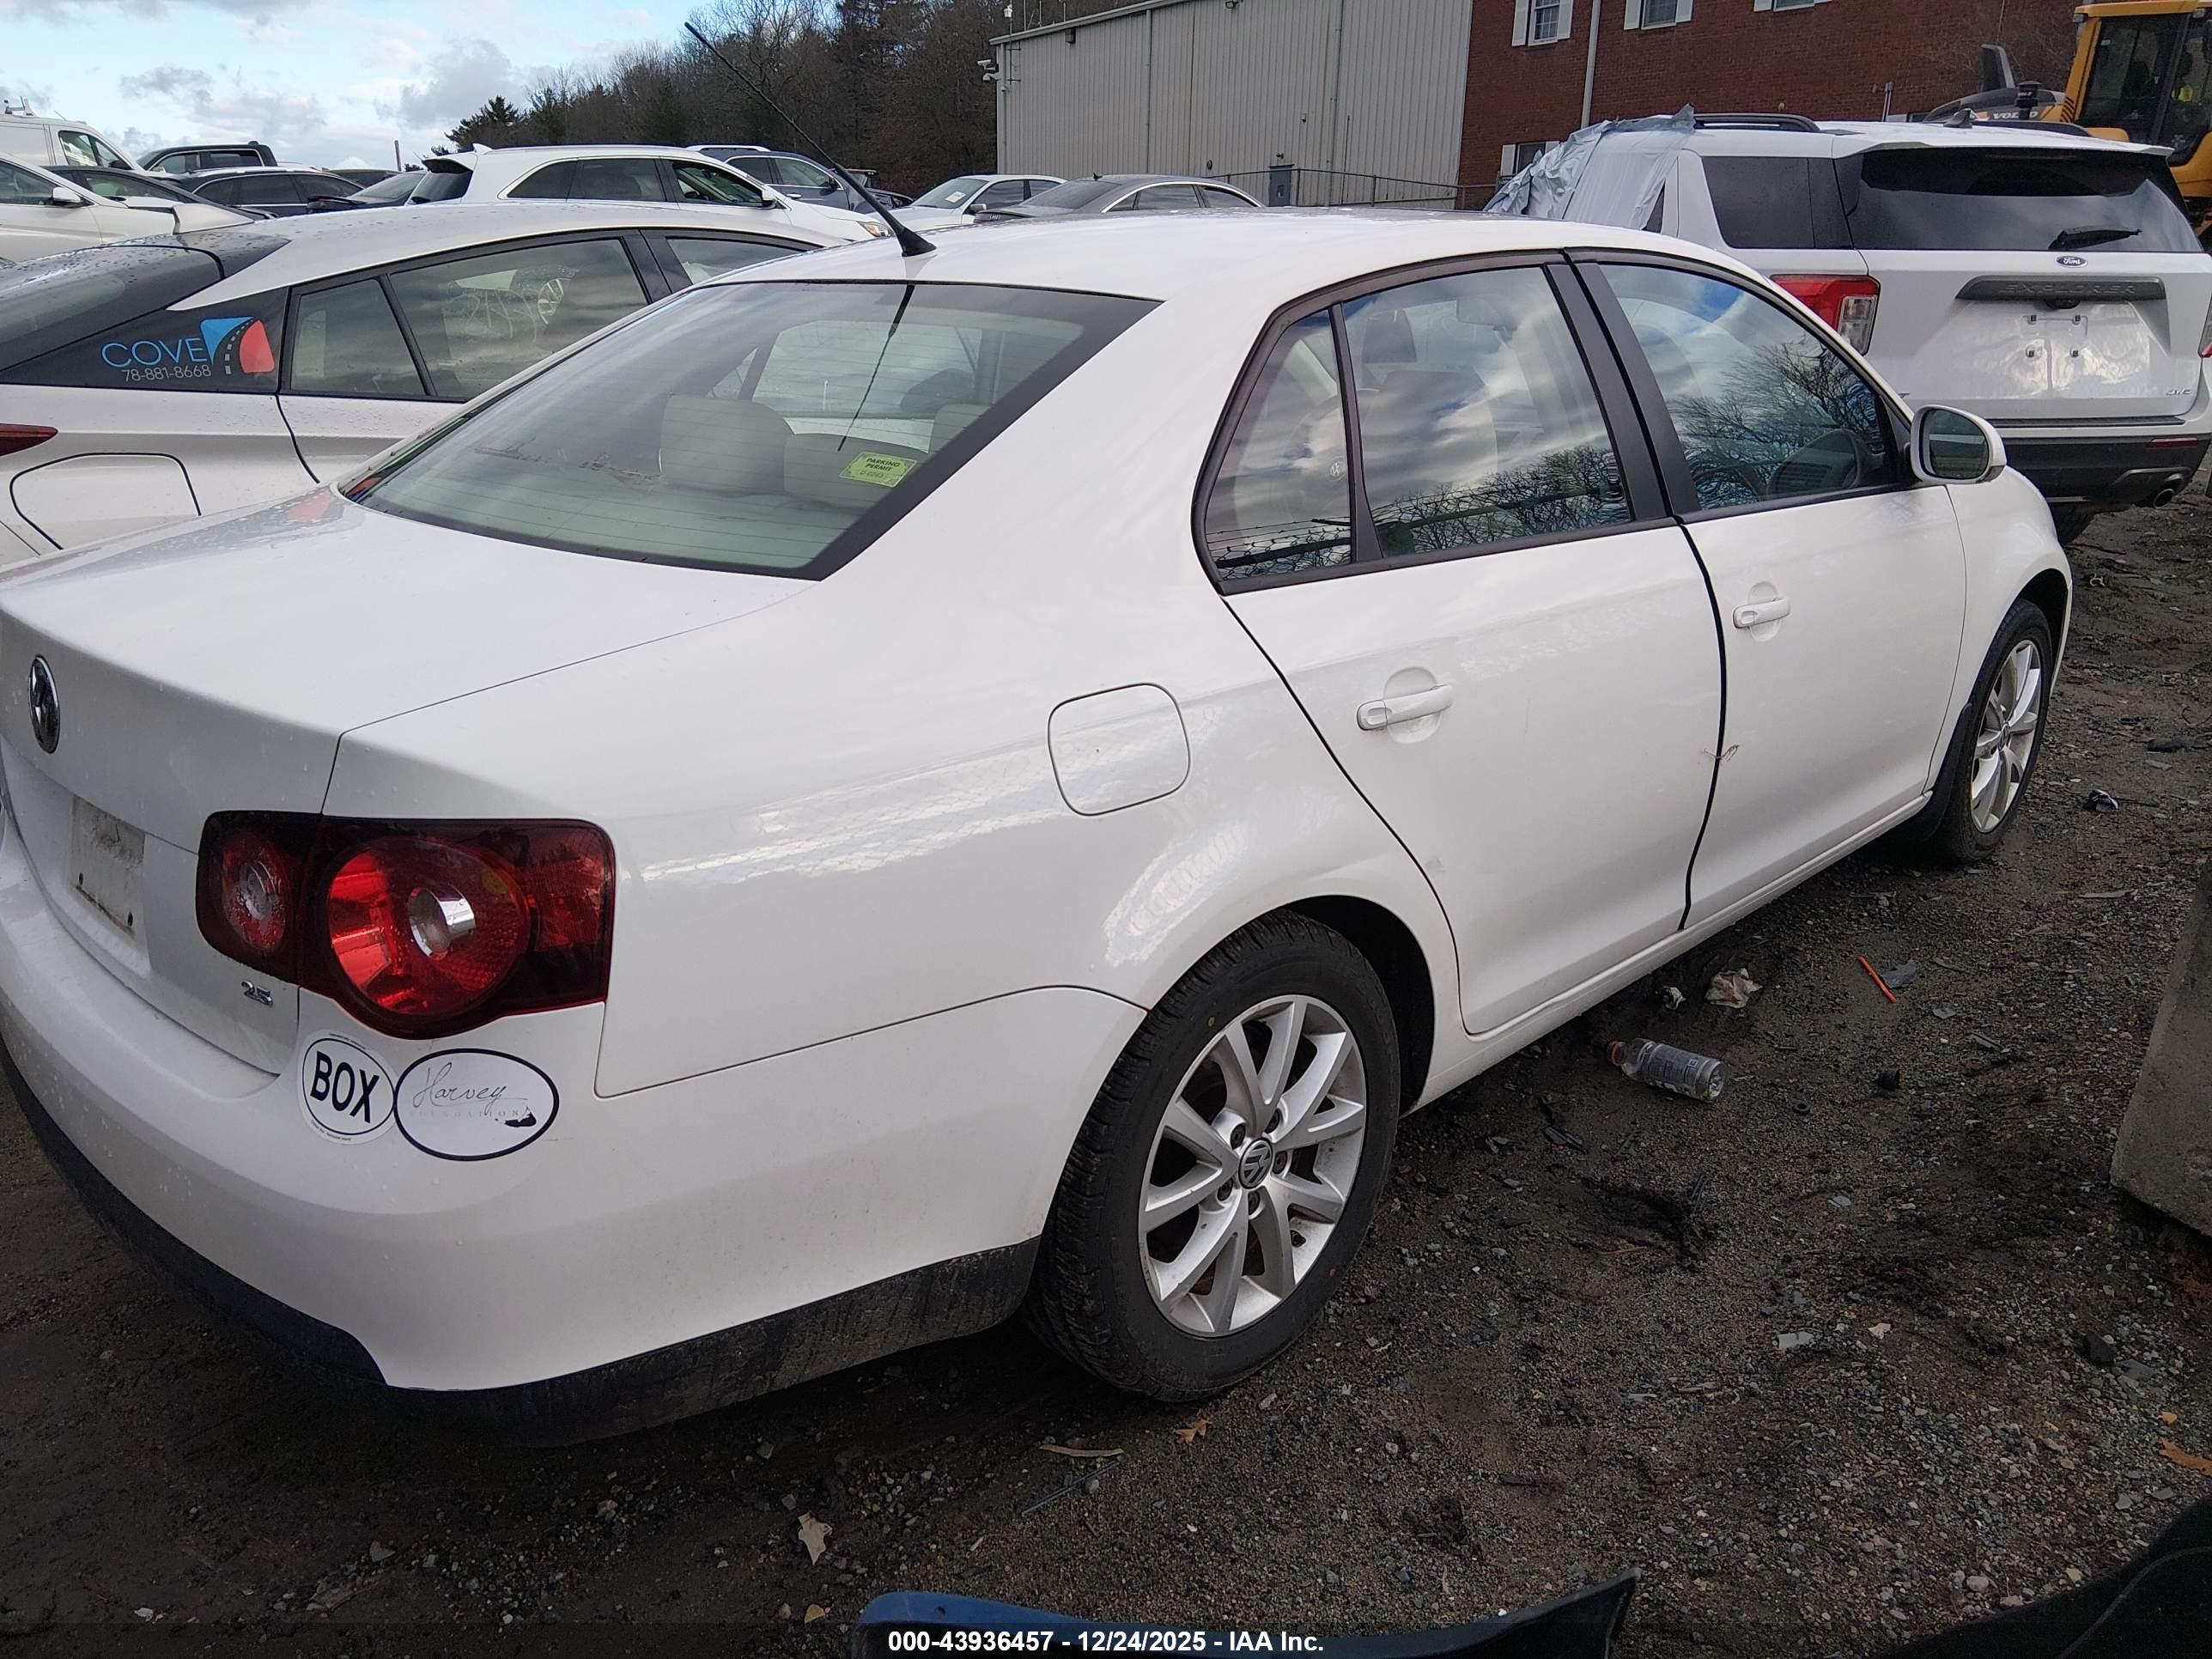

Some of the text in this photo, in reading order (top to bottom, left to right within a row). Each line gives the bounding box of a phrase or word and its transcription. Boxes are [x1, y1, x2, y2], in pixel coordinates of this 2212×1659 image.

[1992, 111, 2039, 119] VOLO
[1998, 283, 2136, 295] EXPLORER
[101, 337, 207, 368] COVE
[121, 364, 212, 382] 78-881-8668
[865, 463, 894, 471] PERMIT
[866, 458, 901, 468] PARKING
[310, 1050, 380, 1124] BOX
[412, 1061, 518, 1116] Harvey
